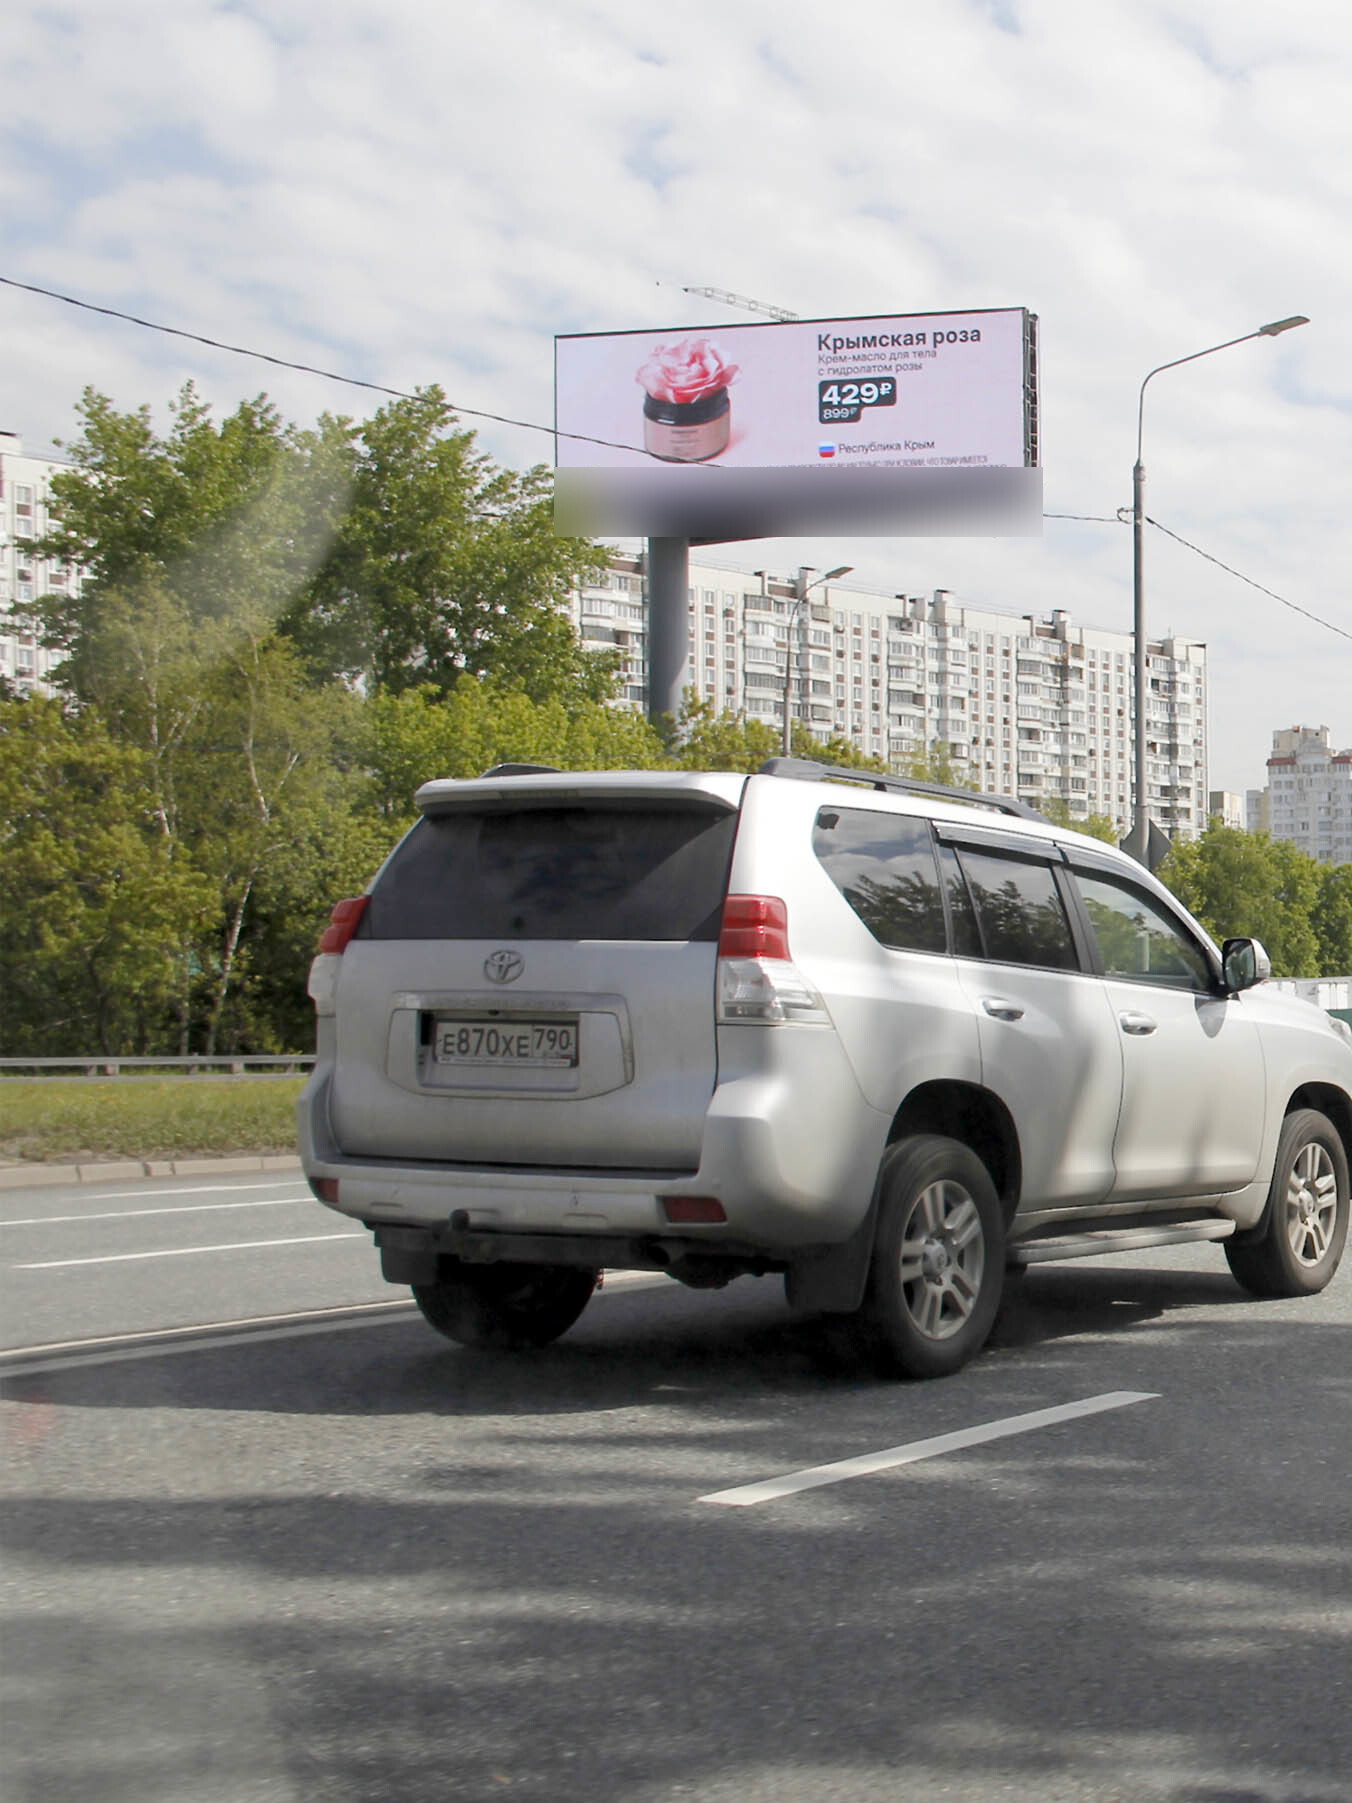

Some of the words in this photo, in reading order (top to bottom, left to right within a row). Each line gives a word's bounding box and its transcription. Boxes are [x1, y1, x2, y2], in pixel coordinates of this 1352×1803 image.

[818, 332, 926, 354] Крымская
[933, 329, 981, 348] роза
[818, 352, 886, 365] Крем-масло
[889, 351, 910, 361] для
[912, 350, 937, 359] тела
[818, 367, 824, 376] с
[827, 364, 893, 377] гидролатом
[896, 362, 923, 373] розы
[838, 442, 902, 455] Республика
[904, 439, 935, 452] Крым
